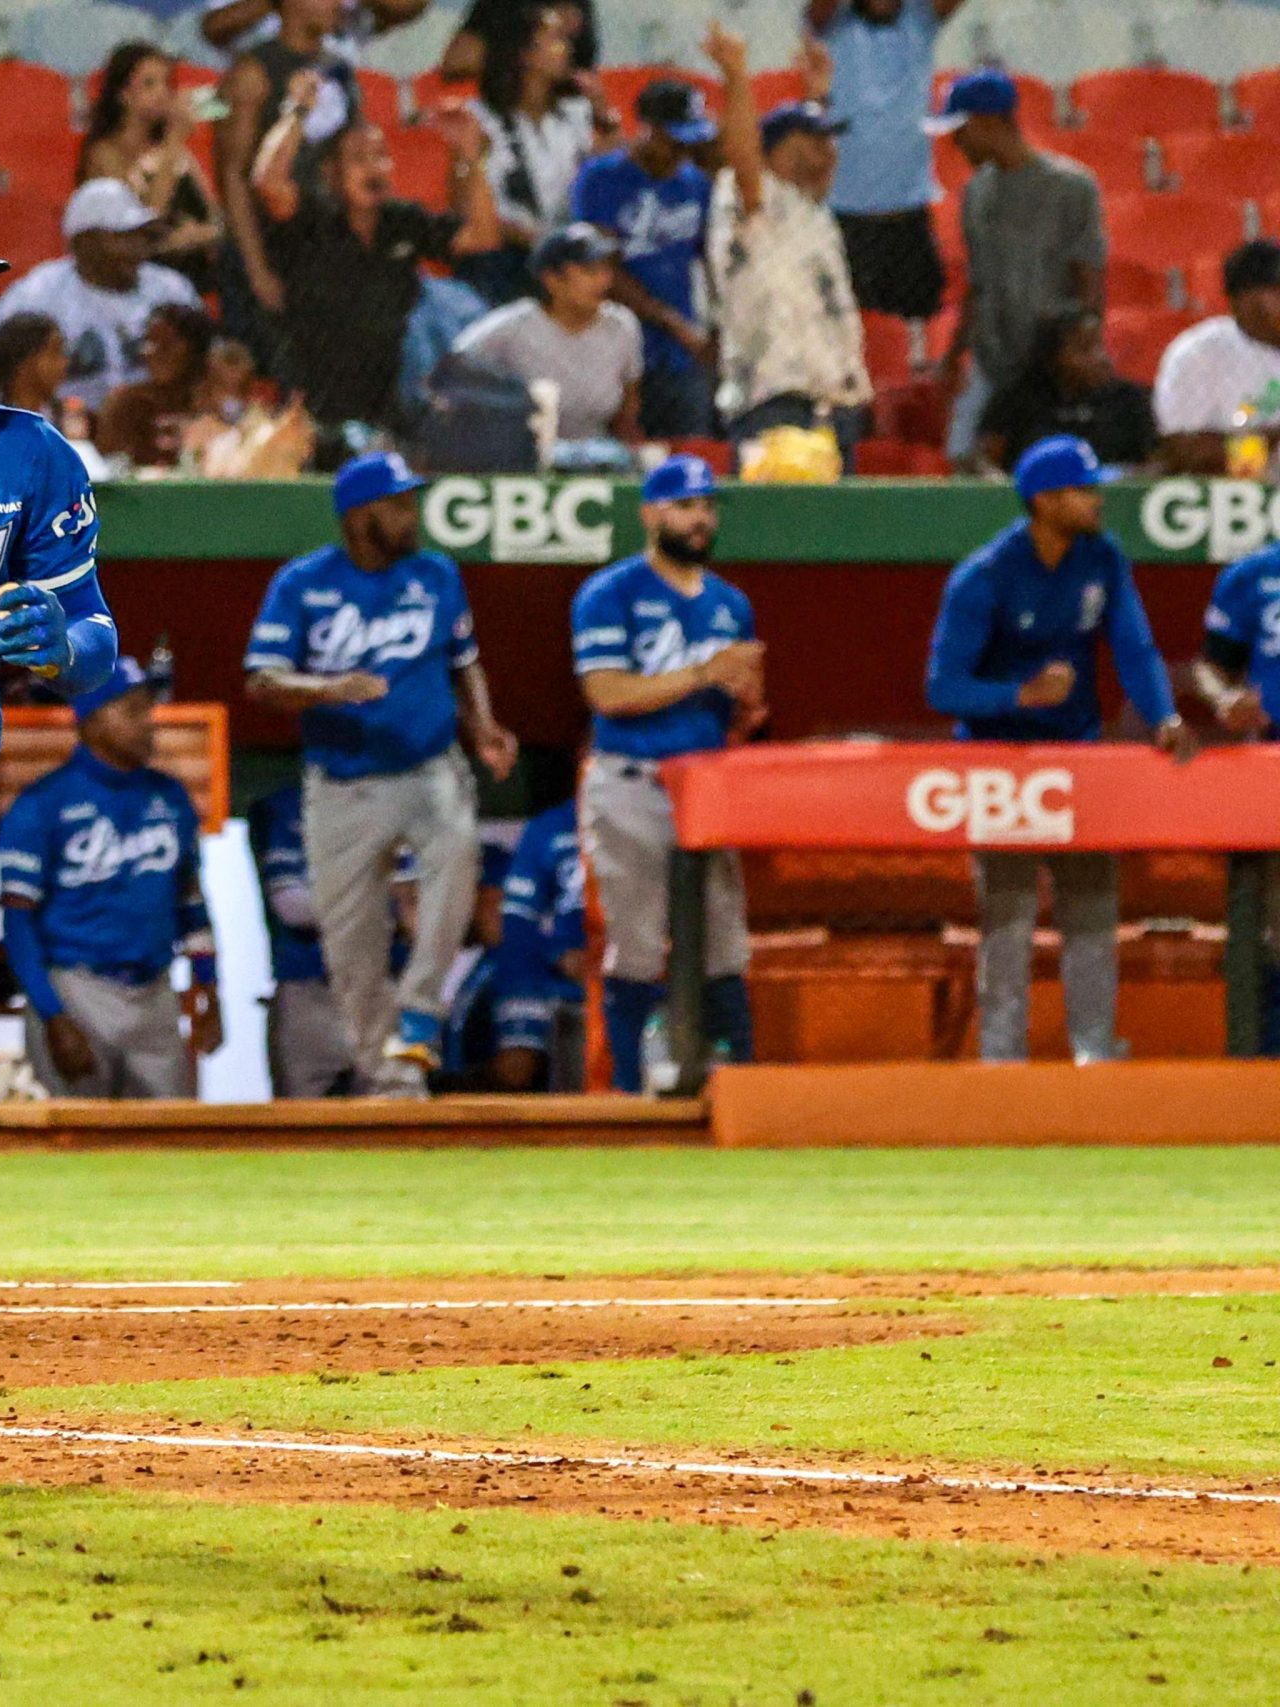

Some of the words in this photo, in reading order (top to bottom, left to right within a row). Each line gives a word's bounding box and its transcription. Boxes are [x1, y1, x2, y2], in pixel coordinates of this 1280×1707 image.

[423, 475, 614, 563] GBC
[1140, 477, 1280, 564] GB
[906, 767, 1075, 844] GBC
